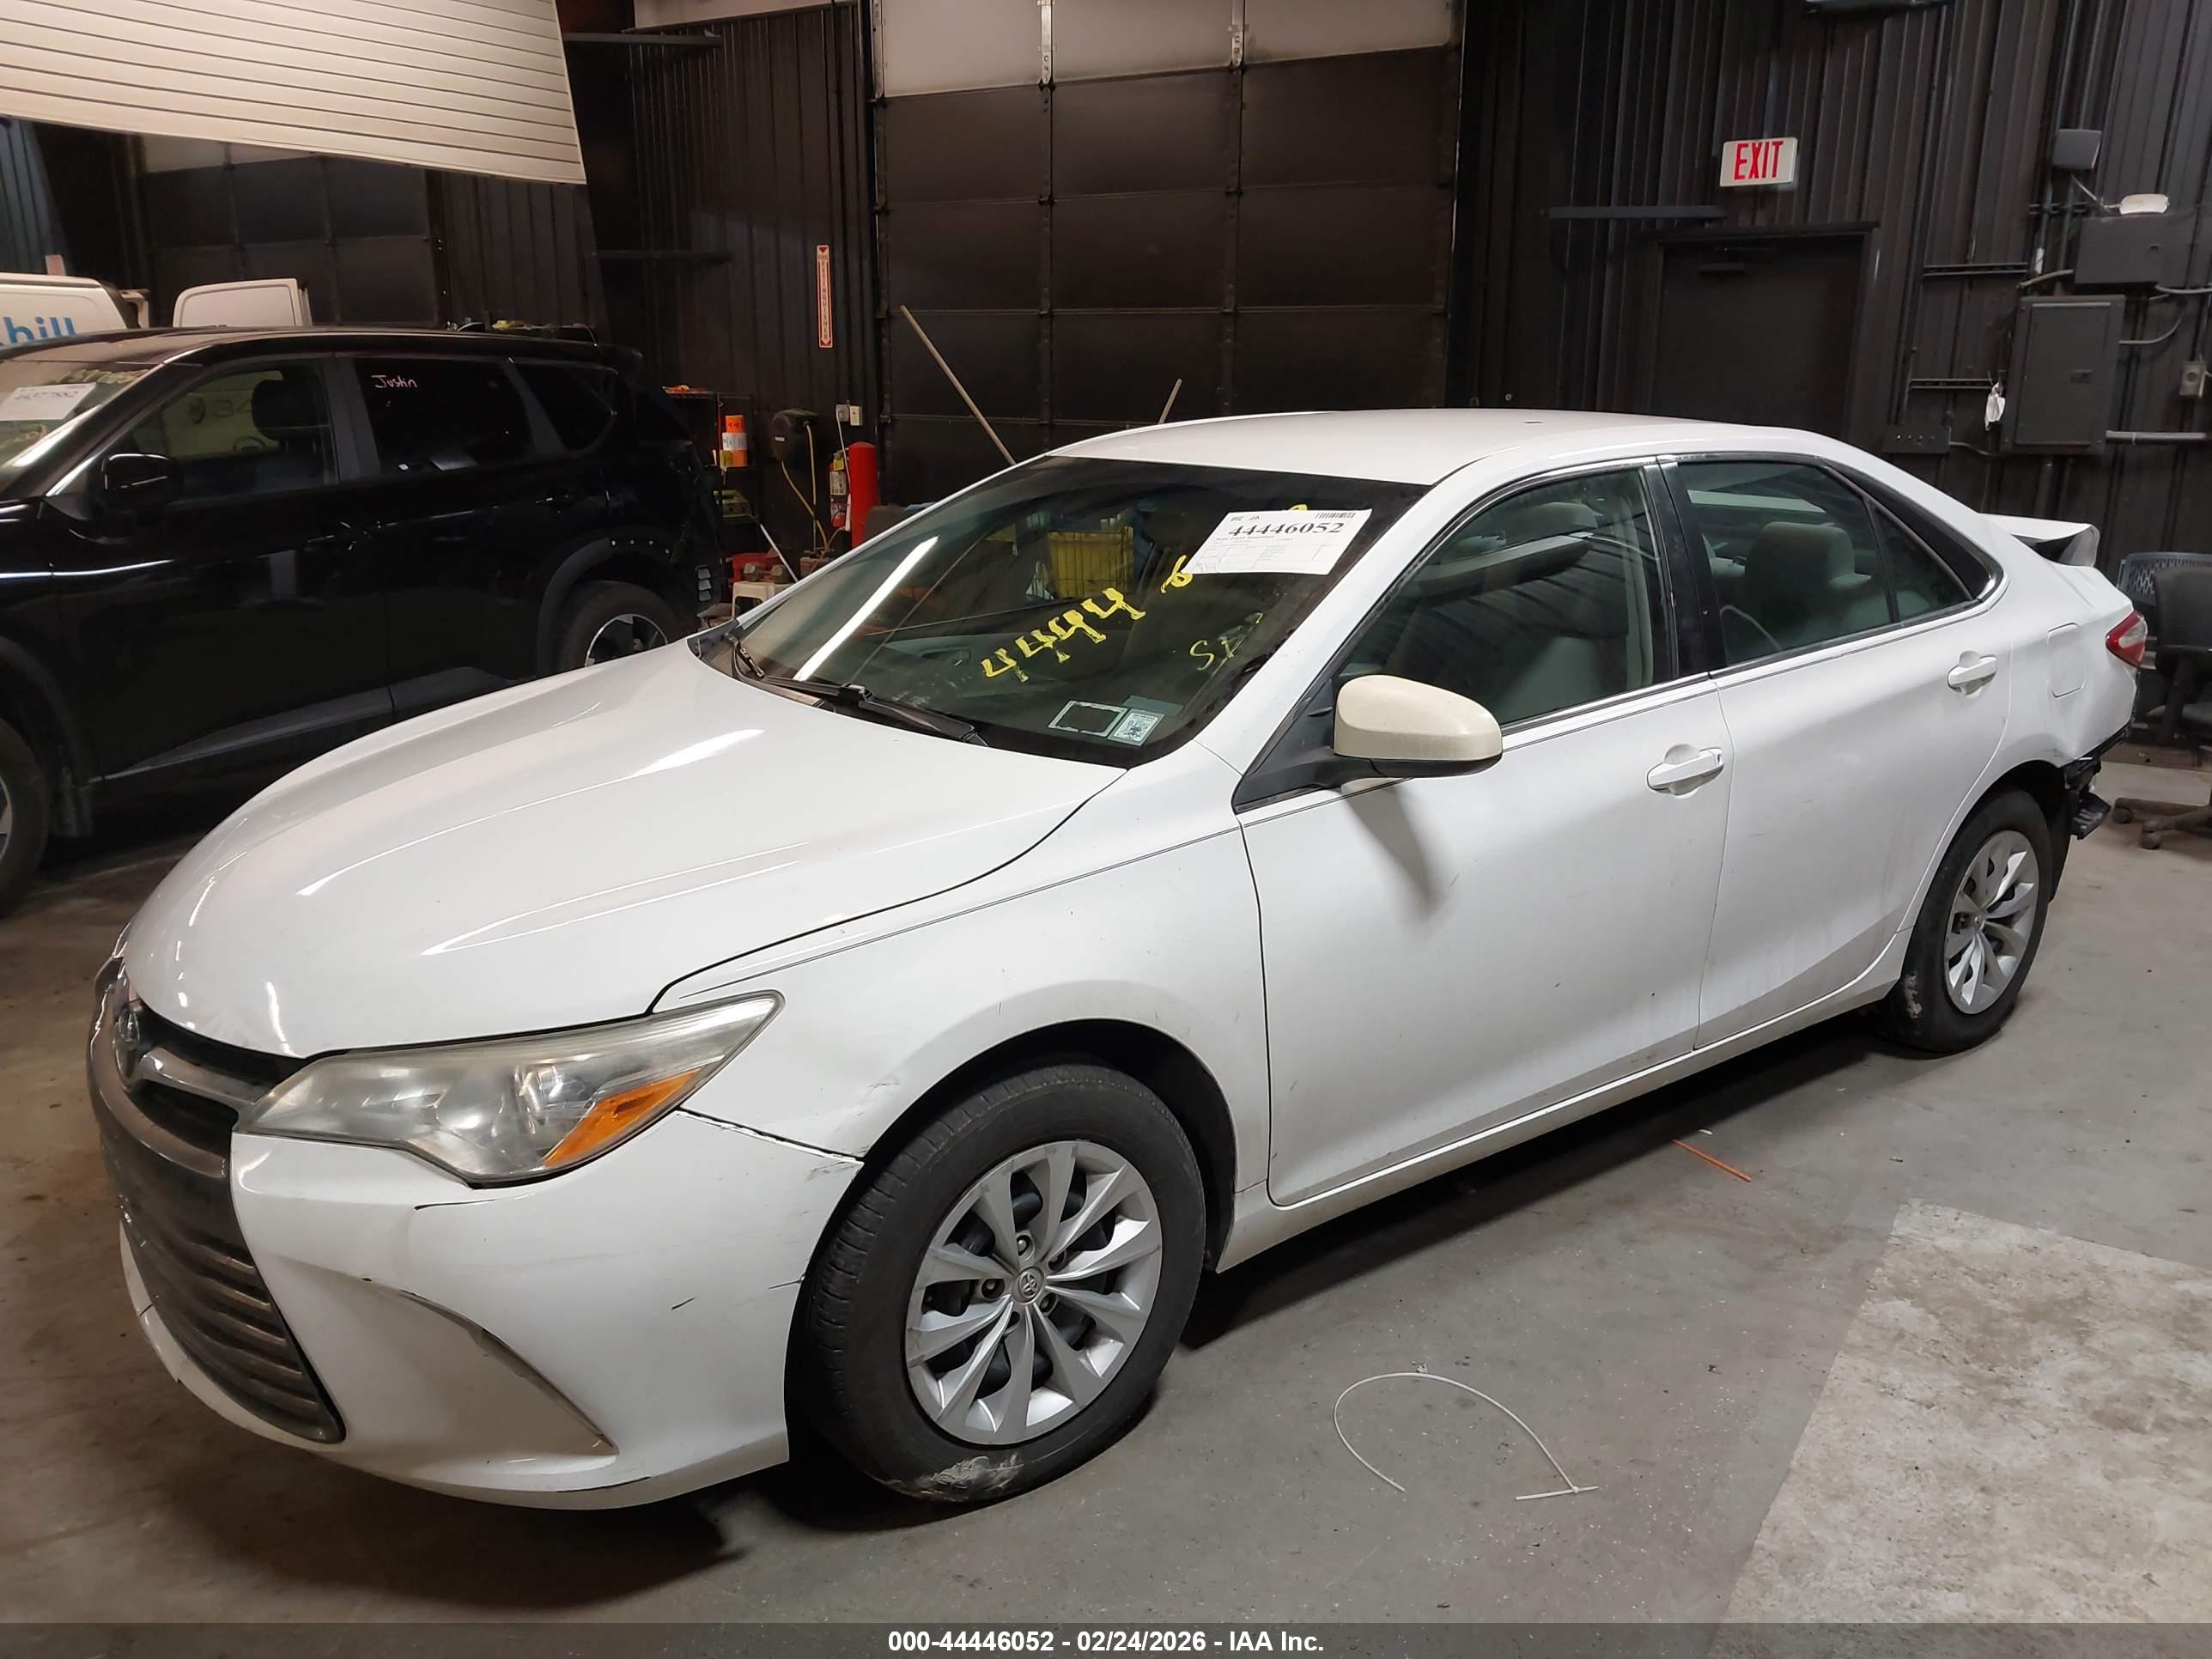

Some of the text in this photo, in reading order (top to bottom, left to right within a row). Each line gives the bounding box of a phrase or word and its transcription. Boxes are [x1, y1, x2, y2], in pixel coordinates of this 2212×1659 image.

[1735, 141, 1784, 179] EXIT
[371, 374, 417, 388] Justin
[1229, 523, 1344, 536] 44446052
